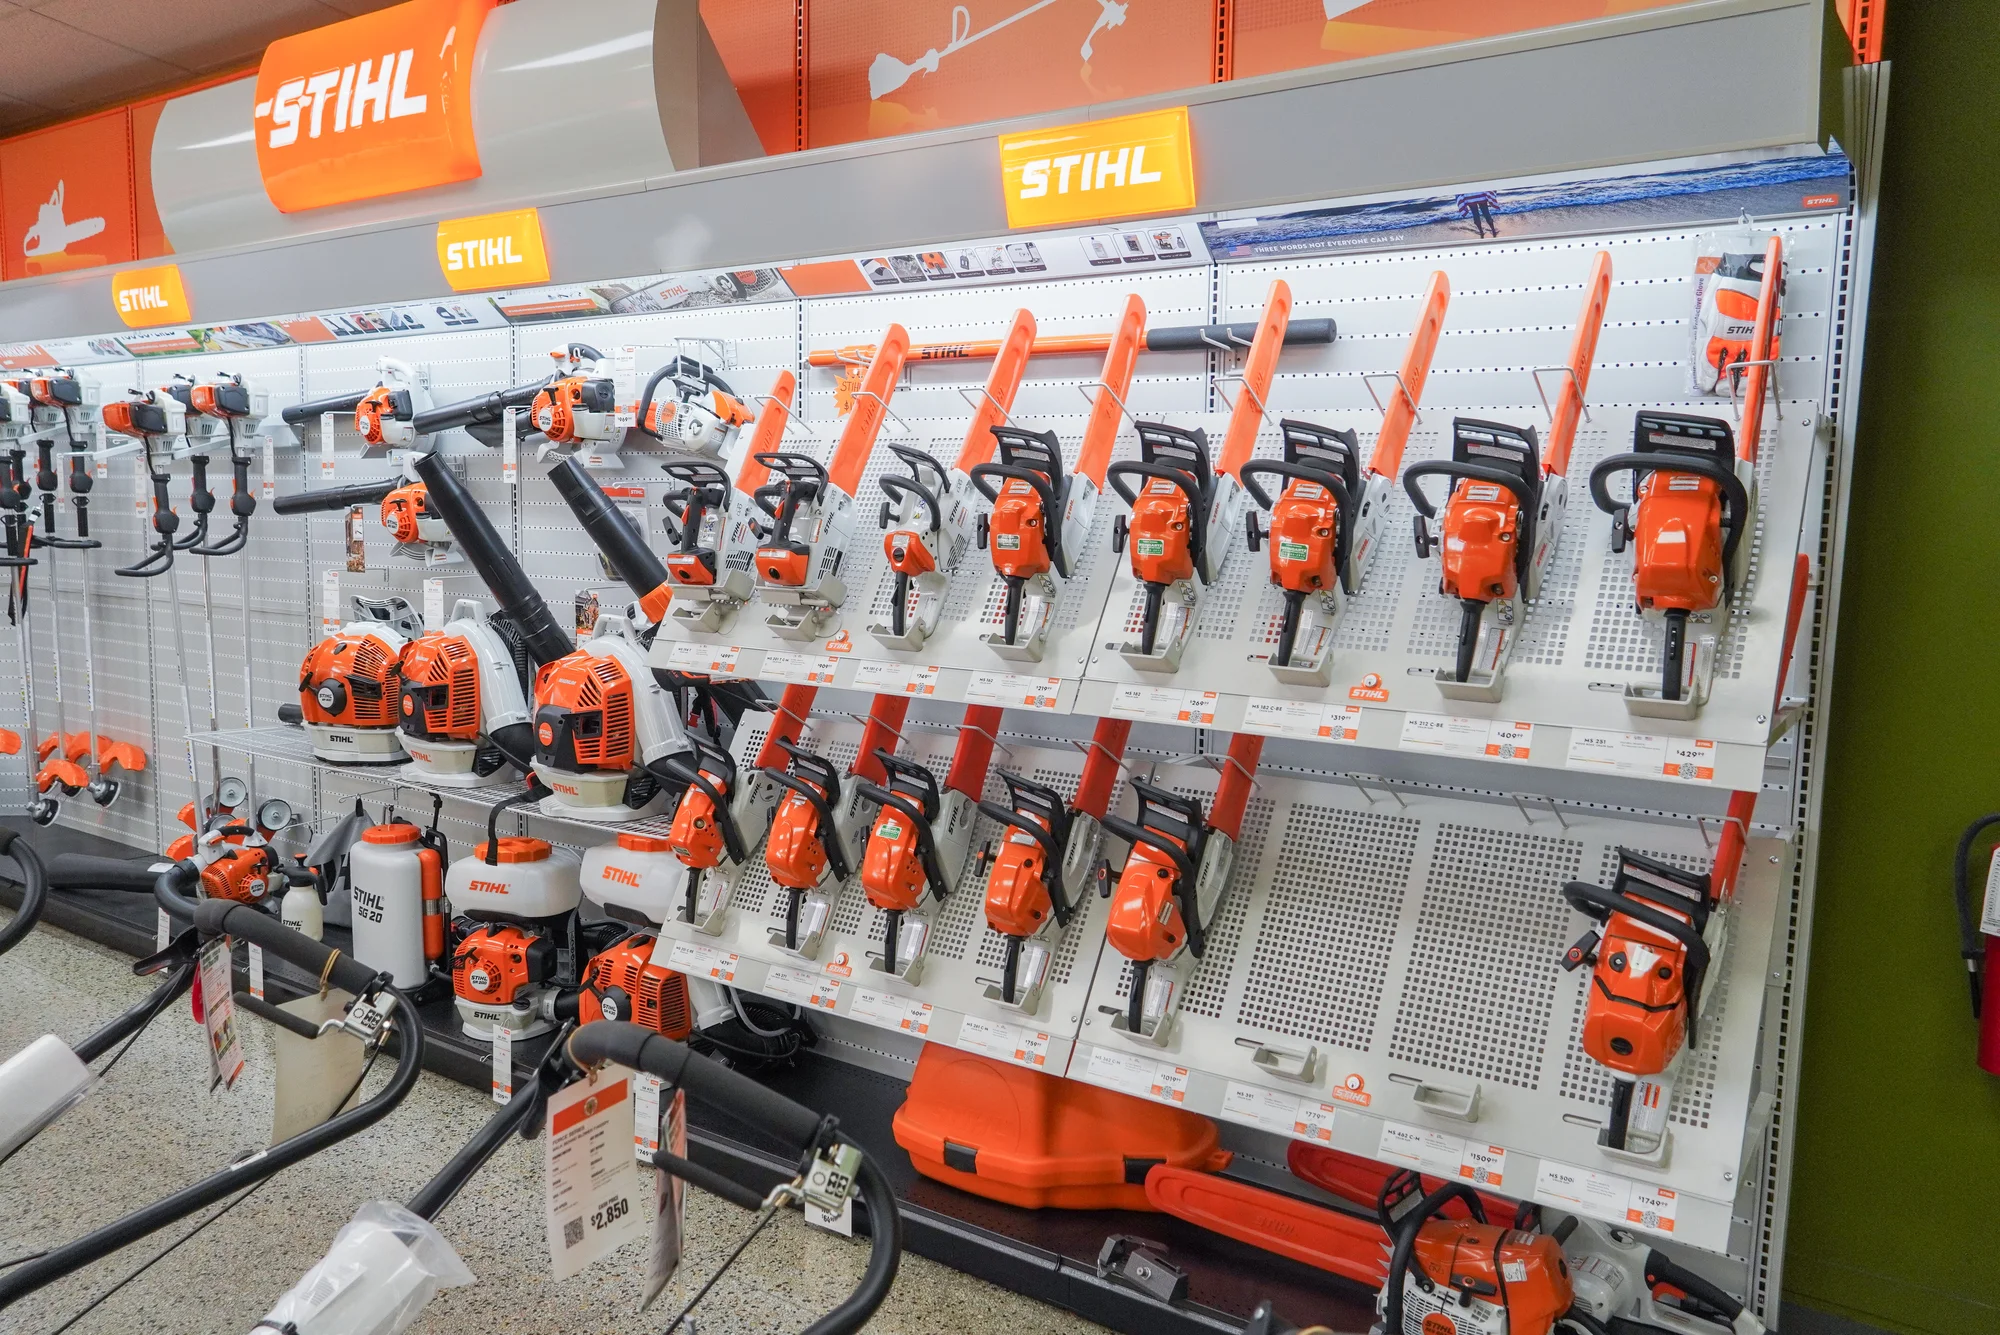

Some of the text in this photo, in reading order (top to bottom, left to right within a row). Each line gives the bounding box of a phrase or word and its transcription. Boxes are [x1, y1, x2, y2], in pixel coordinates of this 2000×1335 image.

[269, 48, 427, 149] STIHL
[1020, 146, 1162, 199] STIHL
[1807, 197, 1834, 205] STIHL
[1254, 245, 1278, 253] THREE
[1280, 243, 1308, 251] WORDS
[1309, 241, 1325, 249] NOT
[1327, 238, 1368, 248] EVERYONE
[1370, 236, 1387, 244] CAN
[447, 236, 523, 270] STIHL
[119, 285, 168, 312] STIHL
[660, 285, 689, 300] STIHL
[1726, 325, 1756, 334] STIH
[921, 345, 969, 359] STIHL
[840, 381, 861, 392] STIH
[949, 499, 961, 524] STIHL
[1066, 499, 1075, 521] STIHL
[1211, 501, 1221, 524] STIHL
[823, 511, 835, 535] STIHL
[731, 521, 742, 543] STIHL
[1357, 538, 1369, 561] STIHL
[1536, 542, 1548, 567] STIHL
[827, 642, 849, 650] STIHL
[1352, 689, 1384, 699] STIHL
[330, 735, 353, 743] STIHL
[411, 750, 432, 762] STIHL
[553, 782, 579, 796] STIHL
[749, 782, 762, 805] STIHL
[948, 804, 960, 835] STIHL
[1066, 840, 1078, 867] STIHL
[603, 865, 640, 888] STIHL
[1199, 859, 1211, 888] STIHL
[469, 880, 509, 894] STIHL
[354, 885, 384, 911] STIHL
[359, 905, 383, 923] SG 20
[283, 919, 302, 927] STIHL
[828, 964, 849, 974] STIHL
[474, 1011, 500, 1020] STIHL
[603, 1003, 616, 1012] STIHL
[1336, 1088, 1366, 1103] STIHL
[1490, 1147, 1503, 1155] STIHL
[1559, 1174, 1574, 1183] 500i
[1659, 1189, 1674, 1197] STIHL
[598, 1195, 619, 1211] CASH PRICE
[591, 1197, 629, 1231] $2,850
[1425, 1319, 1453, 1334] STIHL
